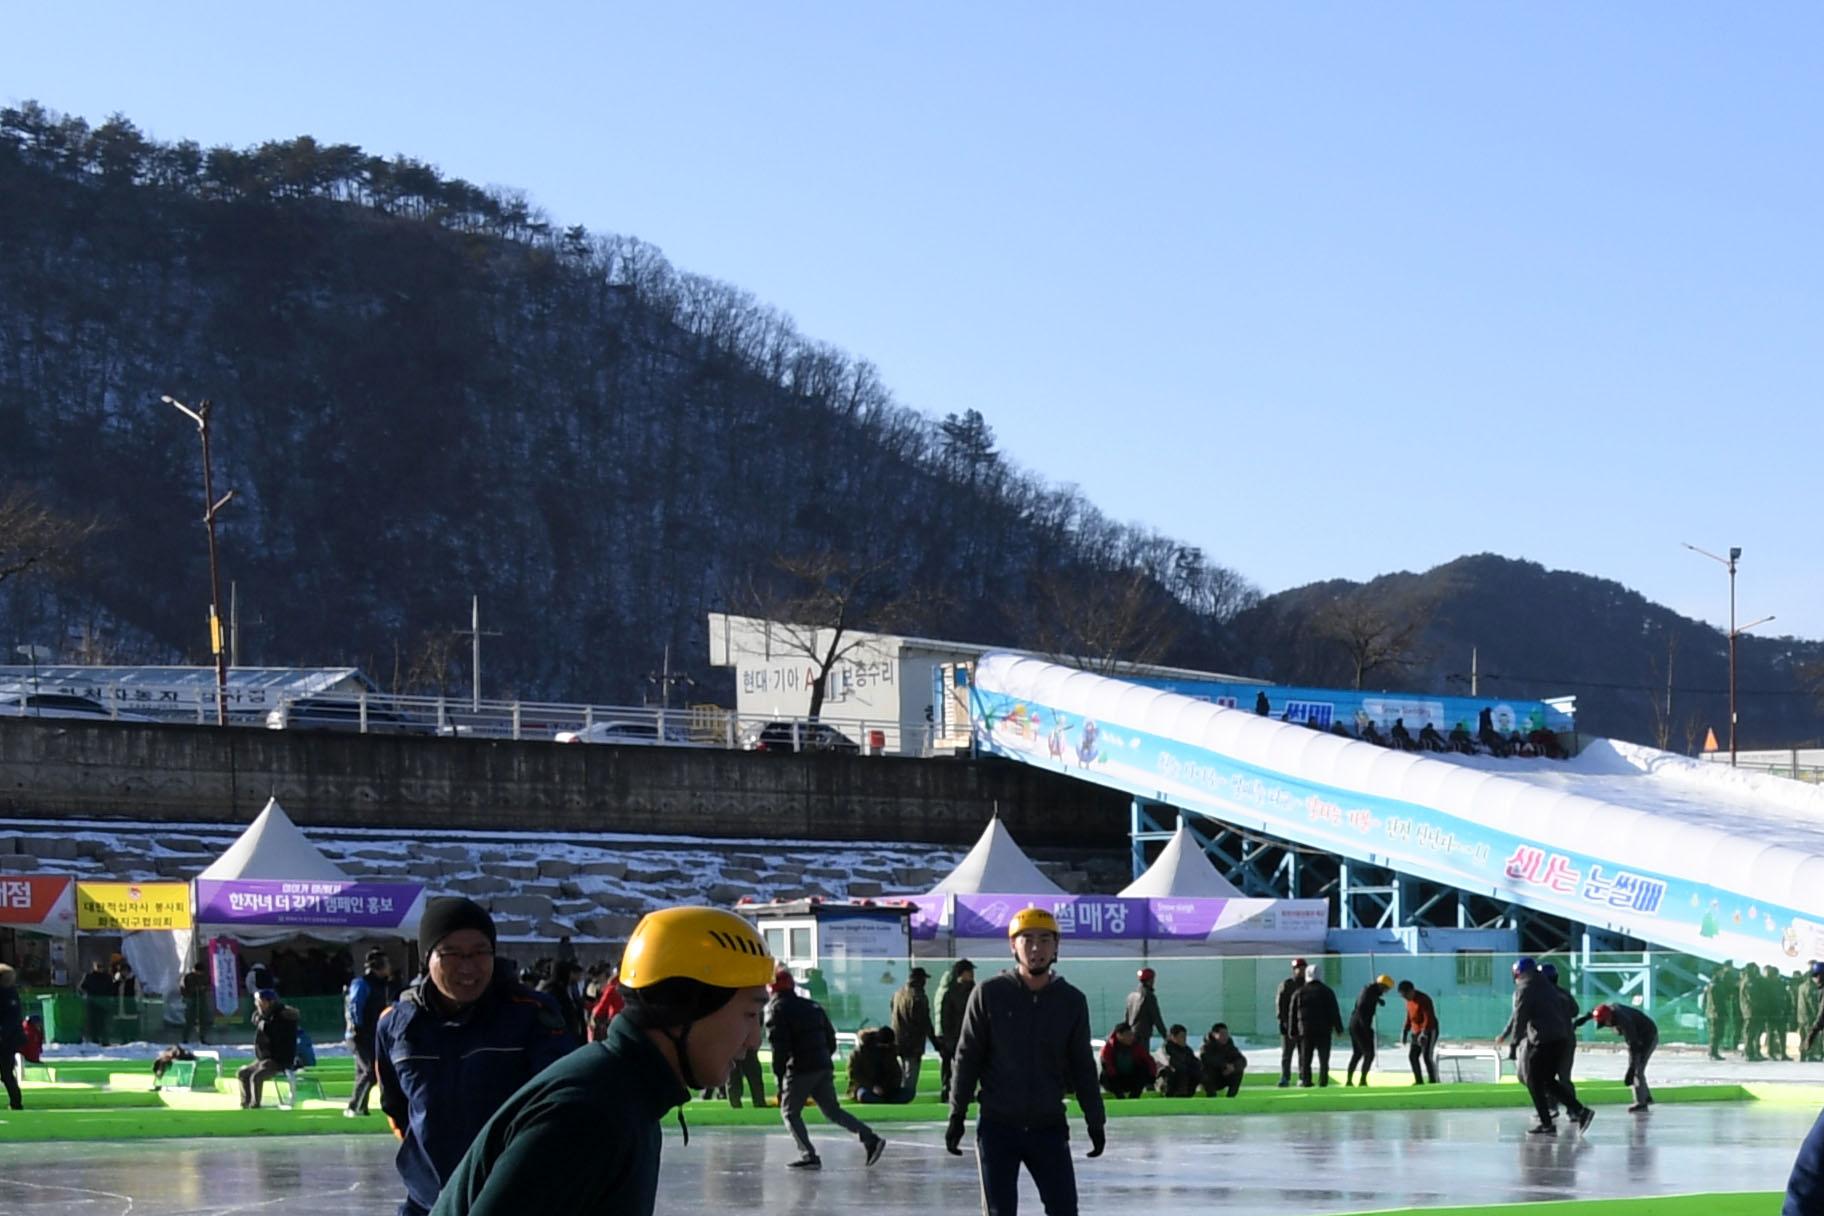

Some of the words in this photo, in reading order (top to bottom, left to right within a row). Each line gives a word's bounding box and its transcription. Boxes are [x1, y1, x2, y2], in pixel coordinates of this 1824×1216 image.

[1505, 847, 1578, 893] 신나는
[1584, 867, 1664, 913] 눈썰매
[83, 901, 149, 913] 대한적십자사
[155, 902, 185, 913] 봉사회
[228, 892, 273, 912] 한자녀
[275, 894, 290, 912] 더
[324, 897, 364, 914] 캠페인
[366, 897, 394, 914] 홍보
[1027, 901, 1129, 934] 썰매장
